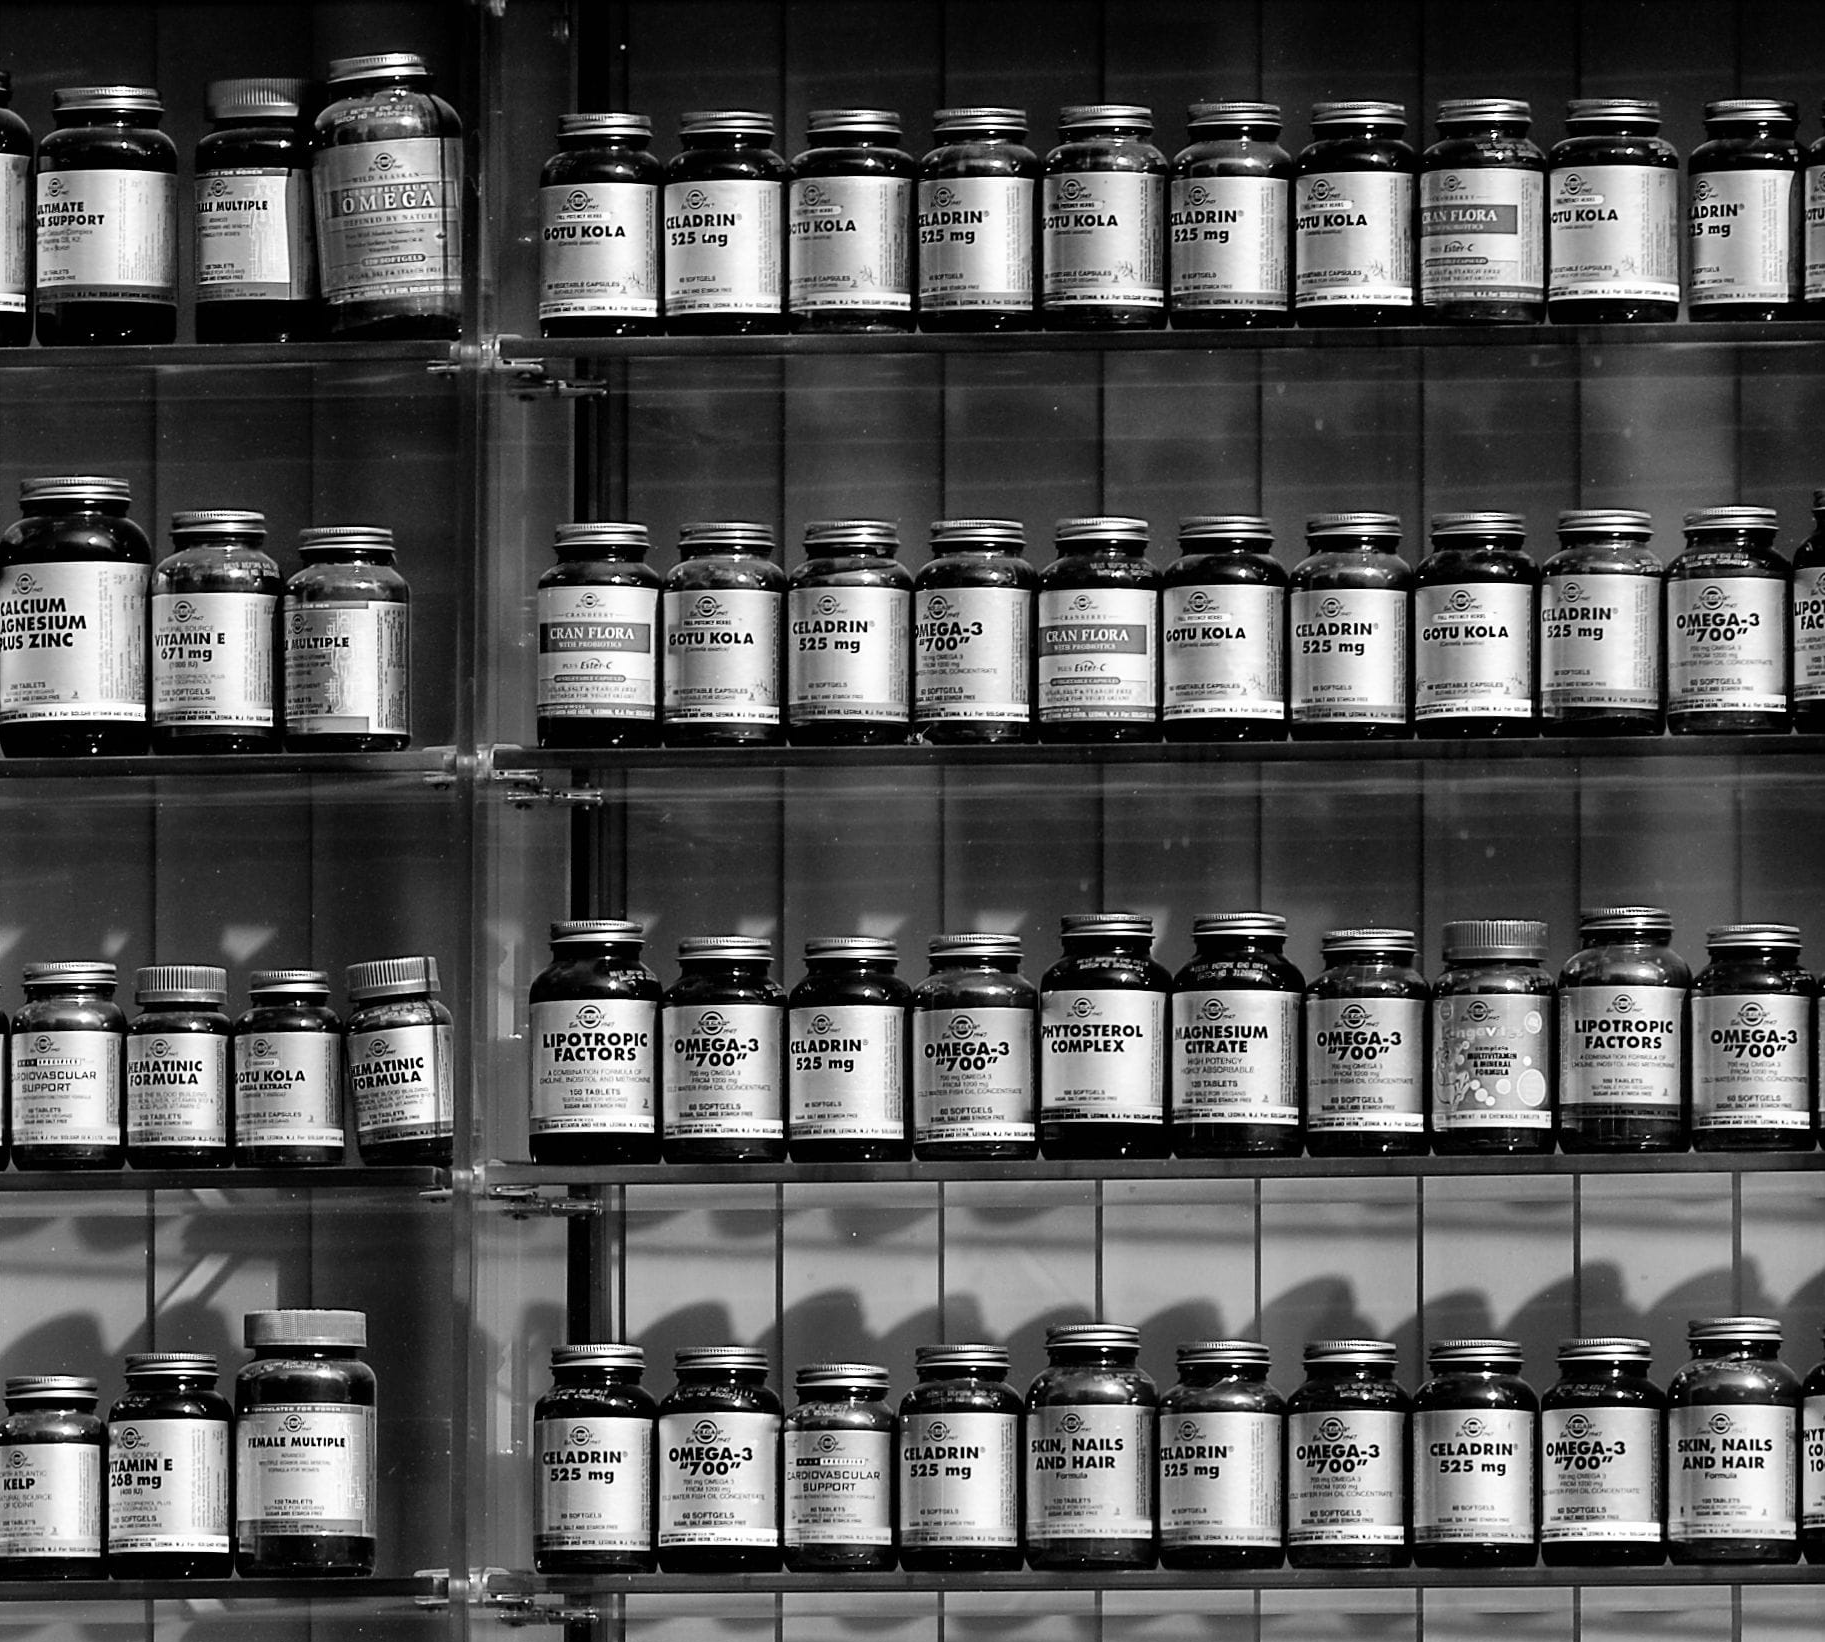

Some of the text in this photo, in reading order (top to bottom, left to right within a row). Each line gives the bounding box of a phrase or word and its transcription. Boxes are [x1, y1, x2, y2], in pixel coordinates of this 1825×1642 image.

[343, 192, 436, 213] OMEGA
[544, 226, 625, 240] GOTU KOLA
[1677, 613, 1759, 629] OMEGA-3
[155, 631, 225, 647] VITAMIN E
[550, 626, 634, 639] CRAN FLORA
[799, 637, 860, 653] 525 mg
[161, 647, 212, 662] 671 mg
[543, 1033, 647, 1048] LIPOTROPIC
[555, 1047, 636, 1062] FACTORS
[1297, 1444, 1380, 1460] OMEGA-3
[1678, 1439, 1772, 1454] SKIN, NAILS
[1683, 1456, 1764, 1470] AND HAIR
[551, 1468, 614, 1484] 525 mg
[787, 1470, 880, 1480] CARDIOVASCULAR
[4, 1478, 35, 1490] KELP
[803, 1482, 855, 1492] SUPPORT
